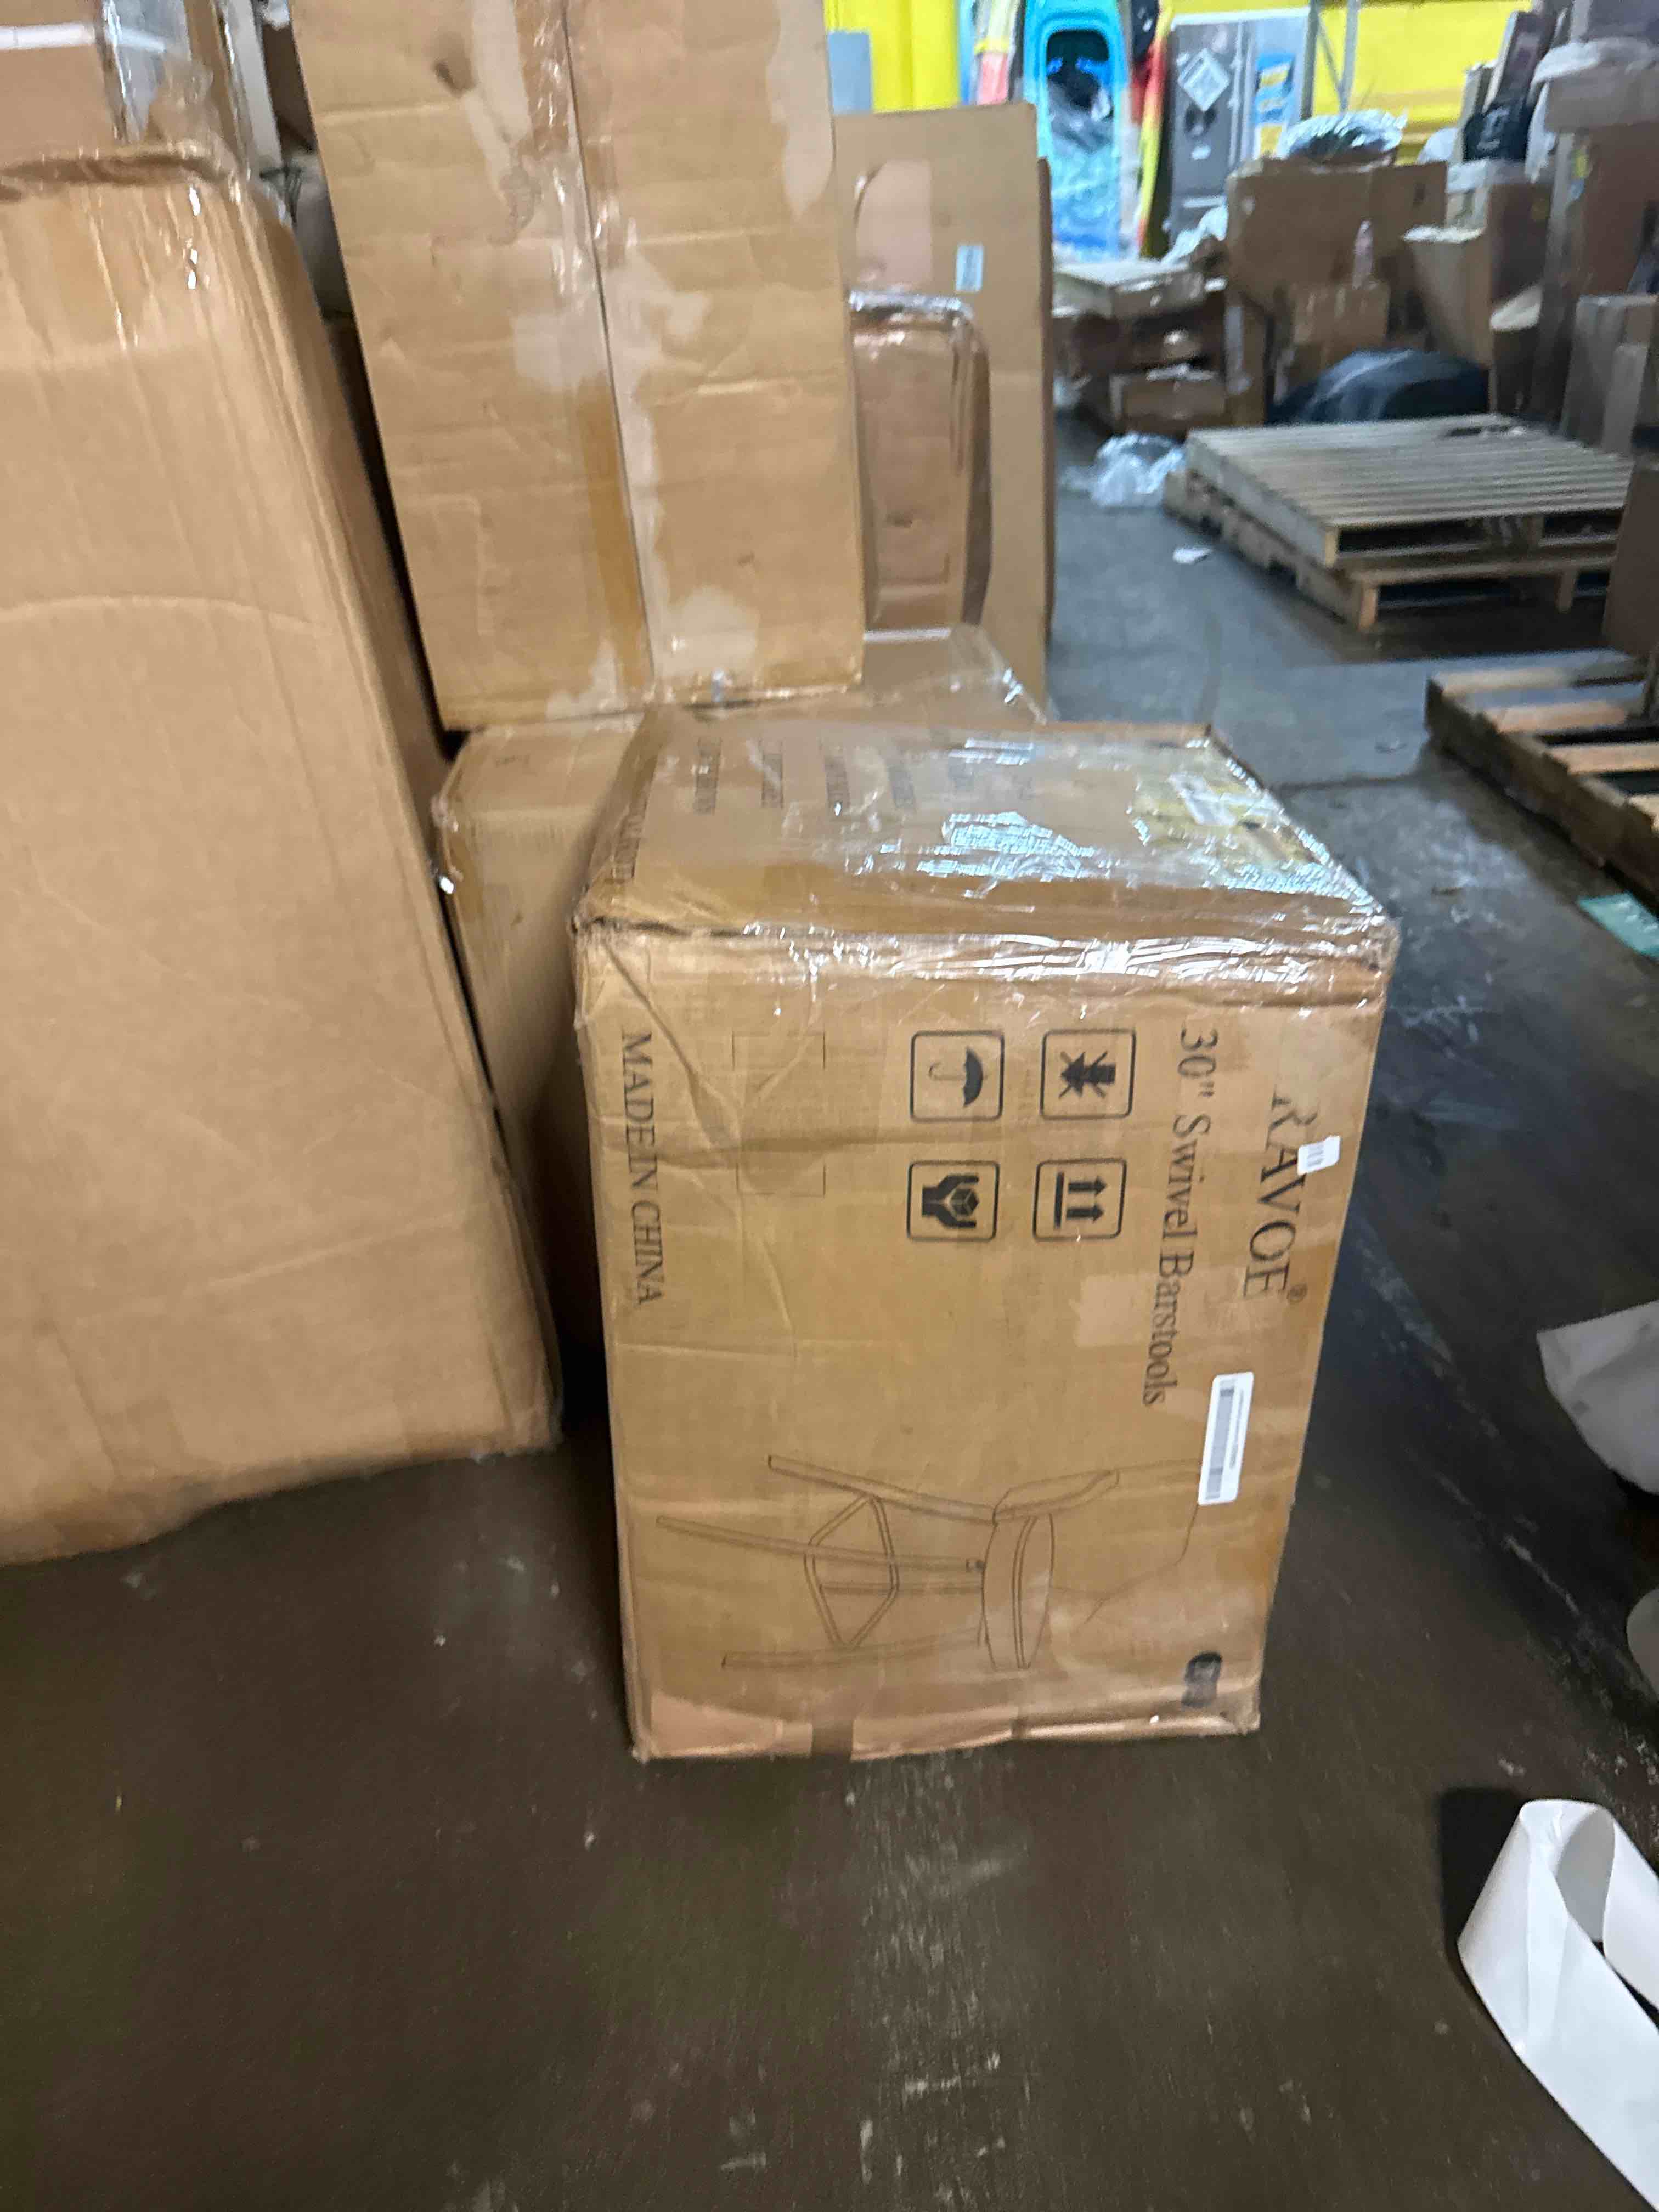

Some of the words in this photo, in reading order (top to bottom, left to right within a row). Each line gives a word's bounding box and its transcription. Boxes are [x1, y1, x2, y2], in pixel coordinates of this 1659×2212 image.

[622, 1026, 654, 1146] MADE
[1178, 1027, 1218, 1097] 30"
[628, 1147, 658, 1194] IN
[1163, 1113, 1211, 1240] Swivel
[631, 1199, 665, 1305] CHINA
[1143, 1248, 1195, 1406] Barstools
